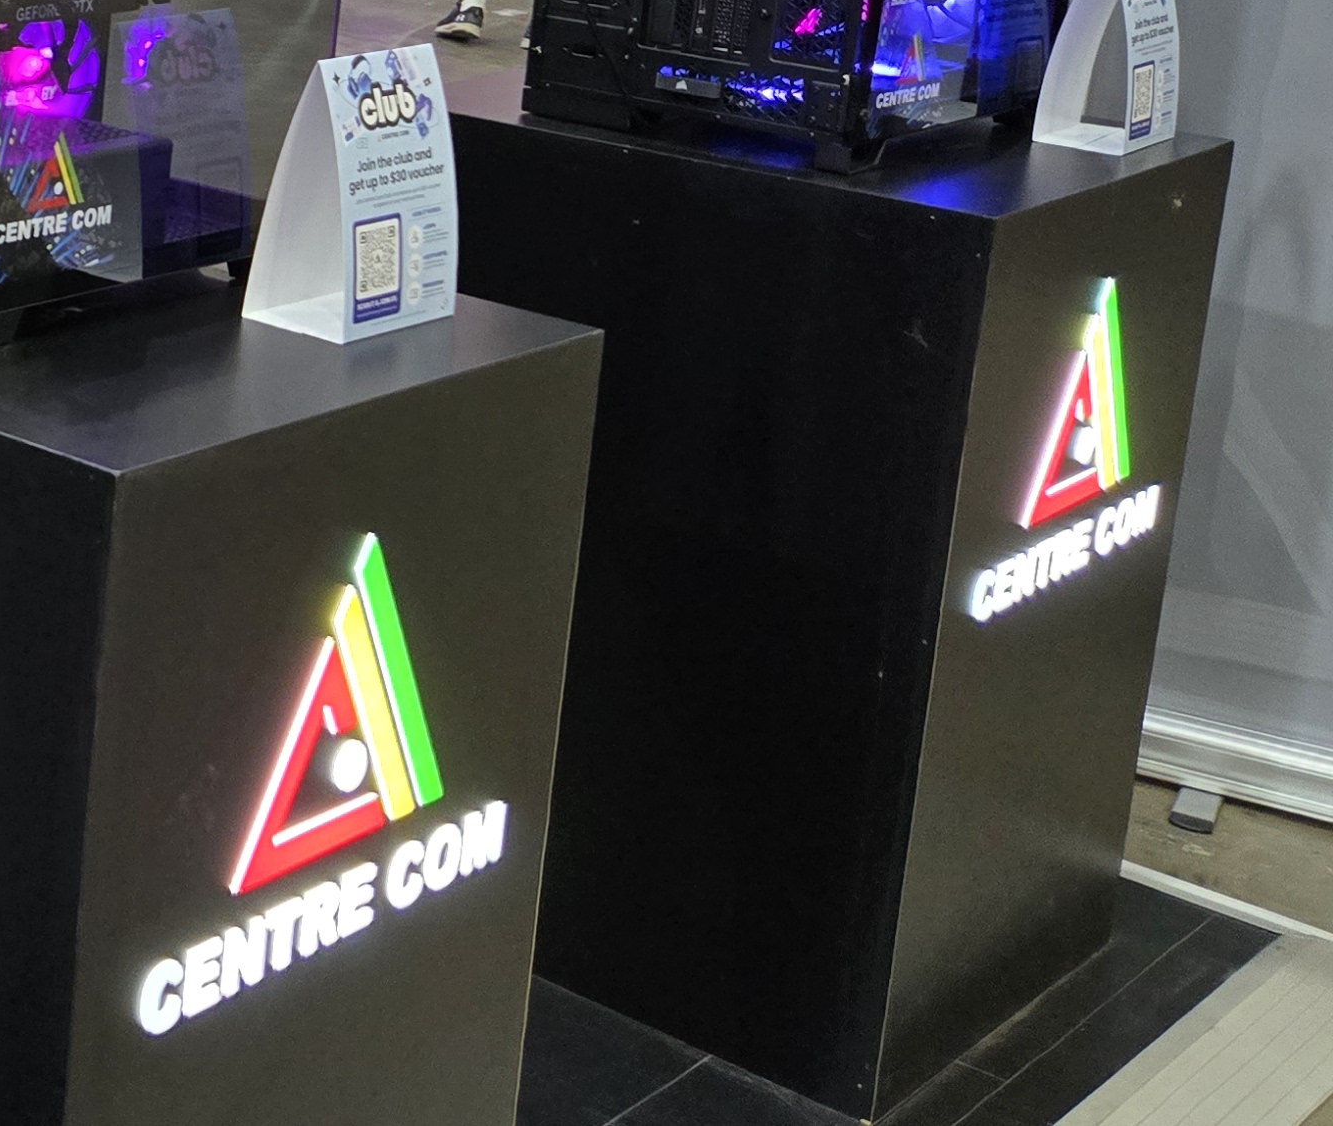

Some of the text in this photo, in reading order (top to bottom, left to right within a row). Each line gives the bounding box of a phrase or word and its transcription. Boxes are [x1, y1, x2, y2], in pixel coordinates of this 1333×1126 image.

[360, 82, 417, 127] club
[876, 82, 941, 109] CENTRE COM
[357, 146, 432, 173] Join the club and
[349, 178, 365, 197] get
[365, 176, 378, 192] up
[379, 174, 390, 186] to
[390, 169, 407, 184] $30
[409, 164, 445, 179] voucher
[72, 204, 113, 230] COM
[970, 483, 1161, 624] CENTRE COM
[138, 799, 510, 1037] CENTRE COM
